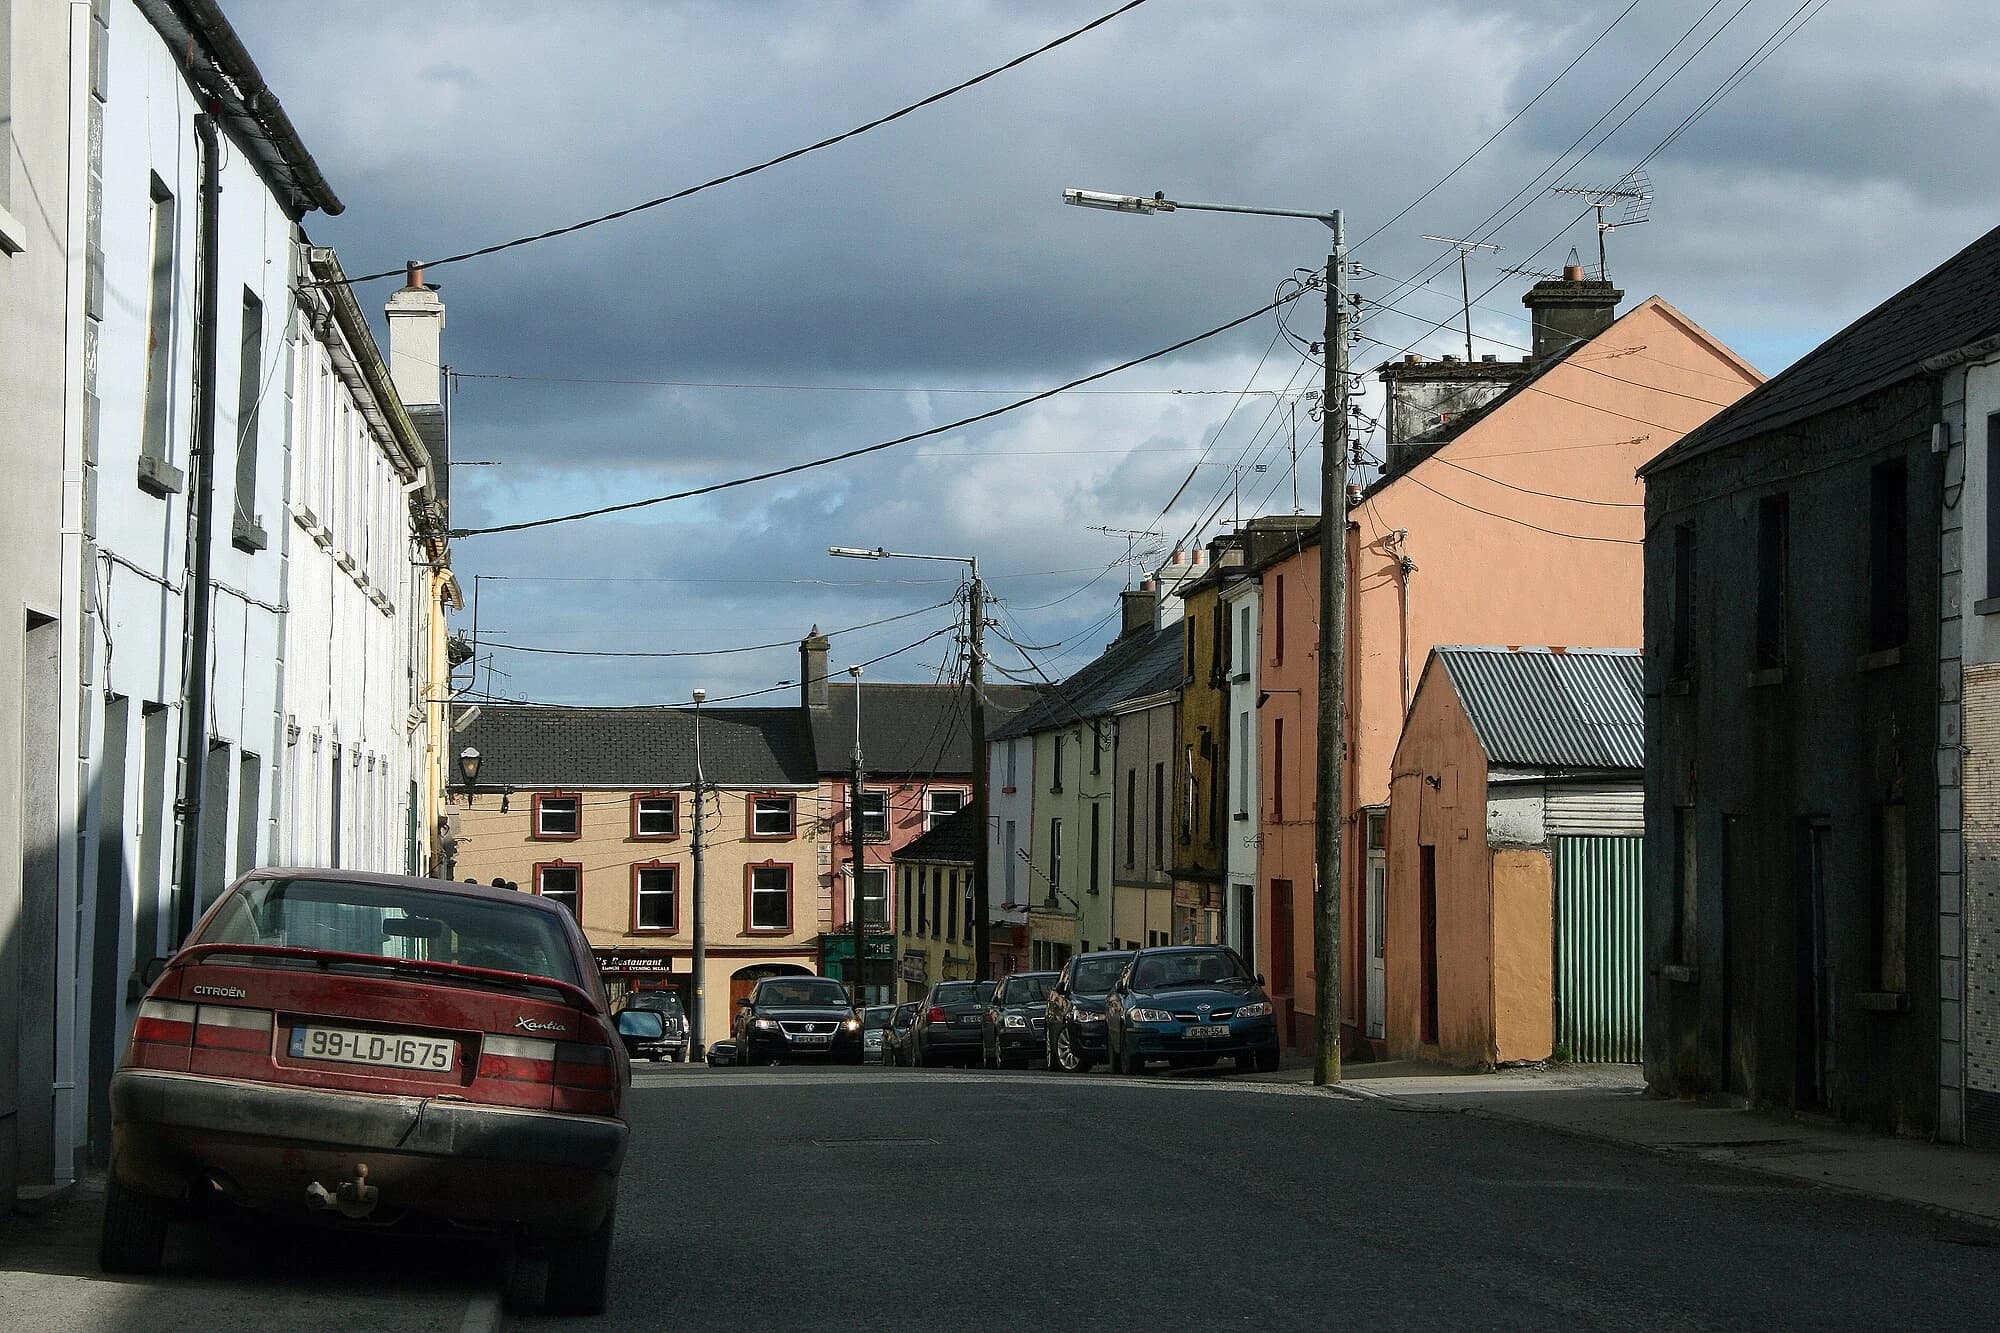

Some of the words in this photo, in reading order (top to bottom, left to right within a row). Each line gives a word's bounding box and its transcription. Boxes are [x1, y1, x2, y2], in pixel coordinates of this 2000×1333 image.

[869, 943, 891, 953] THE
[611, 956, 662, 966] Restaurant
[193, 985, 246, 998] CITROËN
[515, 1016, 567, 1031] Xantia
[311, 1031, 448, 1068] 99-LD-1675
